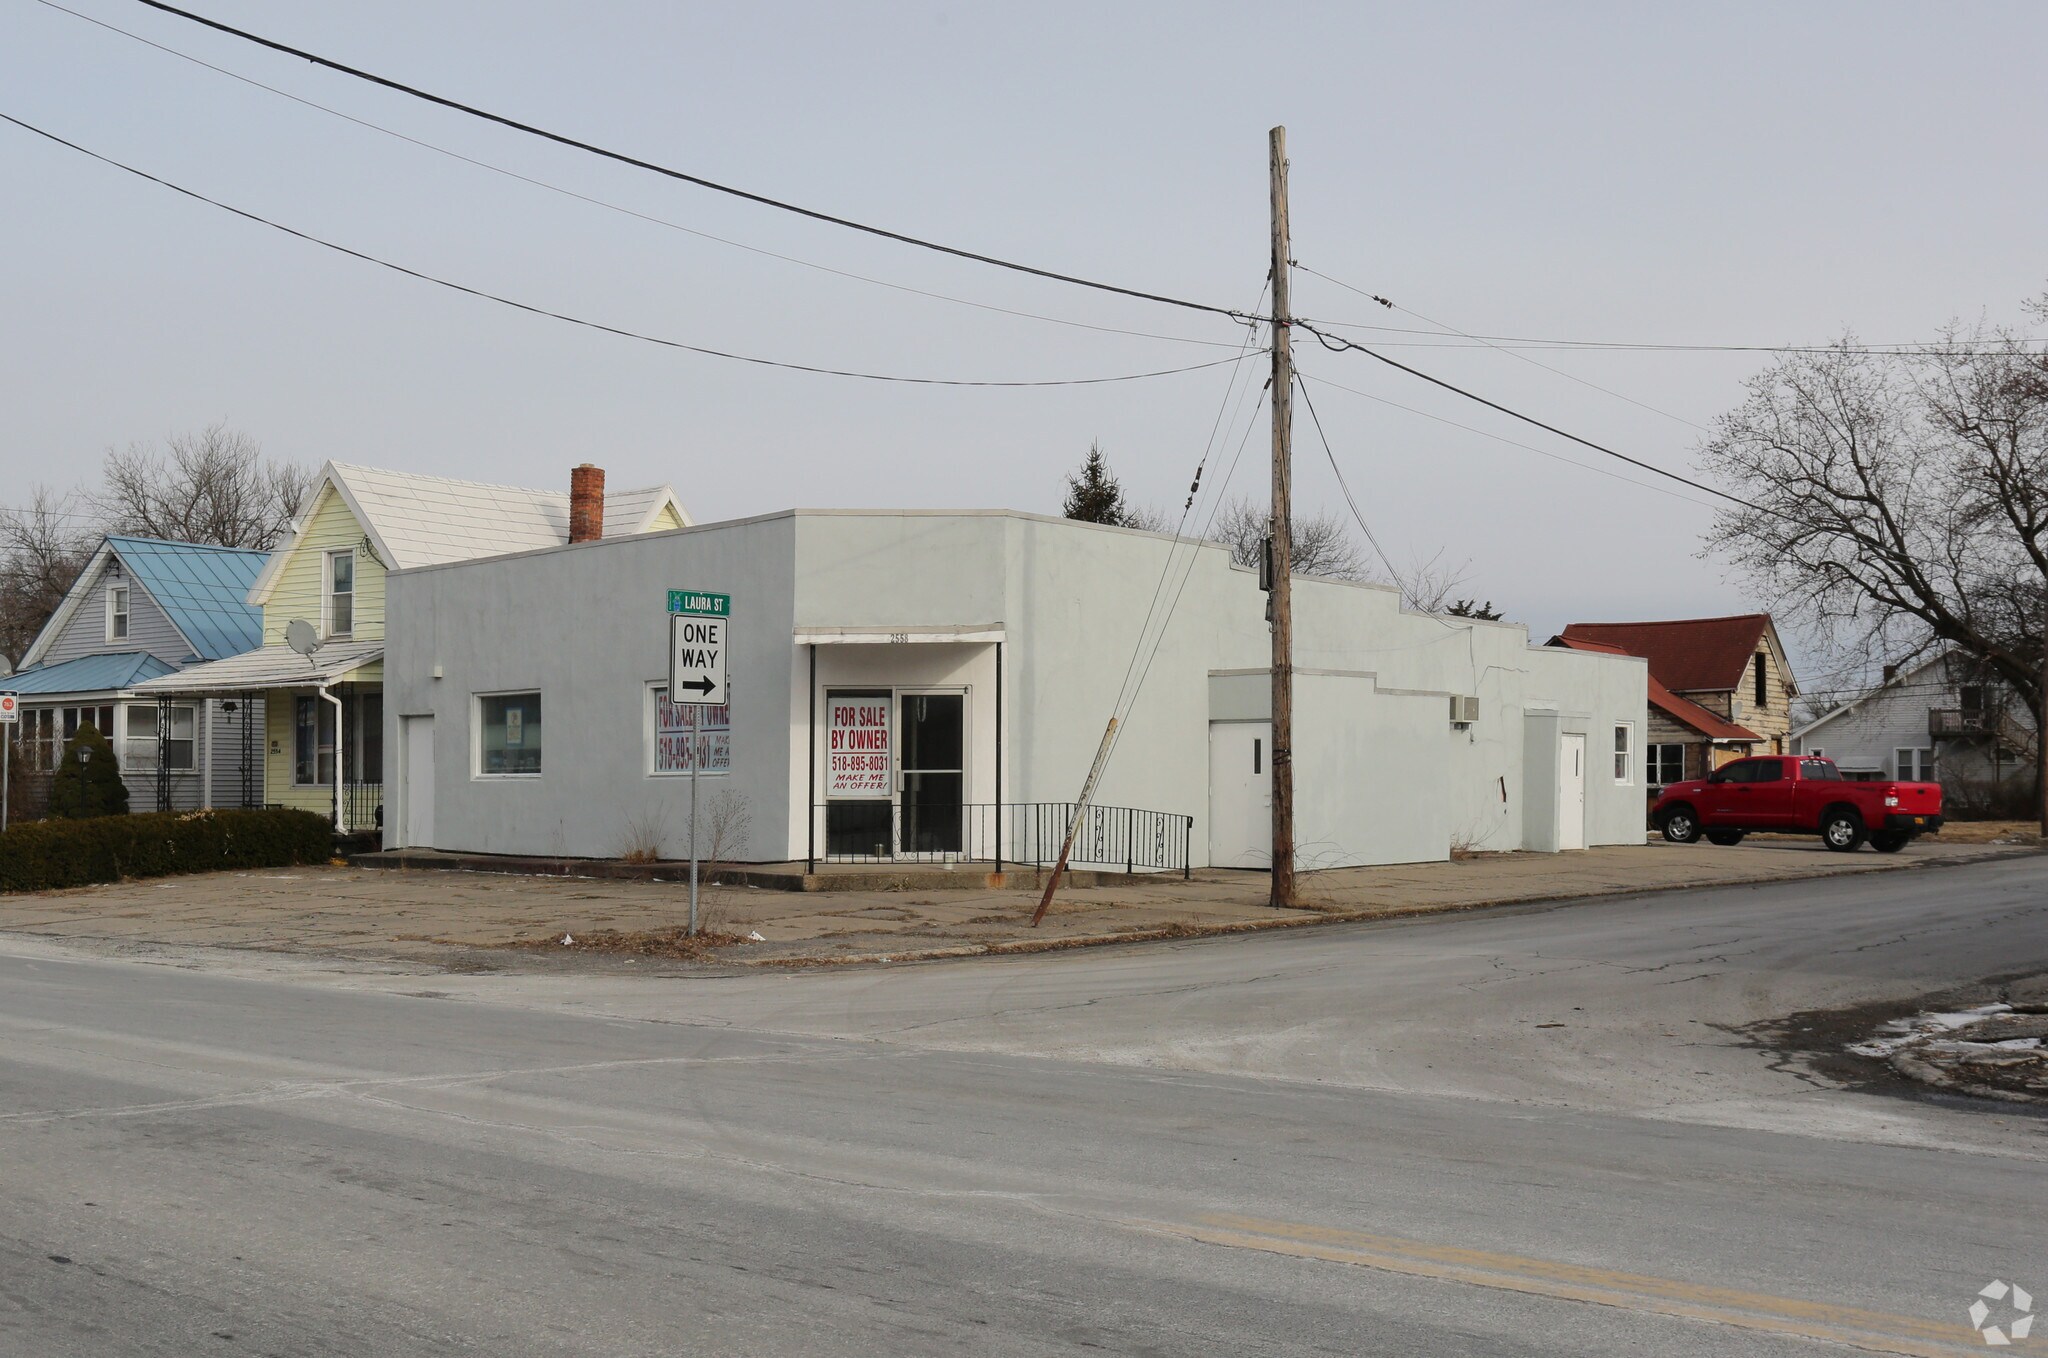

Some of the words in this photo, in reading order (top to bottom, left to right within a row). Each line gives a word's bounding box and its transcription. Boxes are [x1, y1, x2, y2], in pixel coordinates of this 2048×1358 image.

[684, 595, 712, 611] LAURA
[714, 598, 723, 612] ST
[683, 623, 718, 644] ONE
[682, 648, 718, 669] WAY
[834, 706, 856, 727] FOR
[859, 706, 886, 727] SALE
[831, 729, 845, 750] BY
[848, 729, 888, 750] OWNER
[832, 755, 888, 771] 518-895-8031
[833, 782, 847, 790] AN
[850, 782, 888, 790] OFFER!
